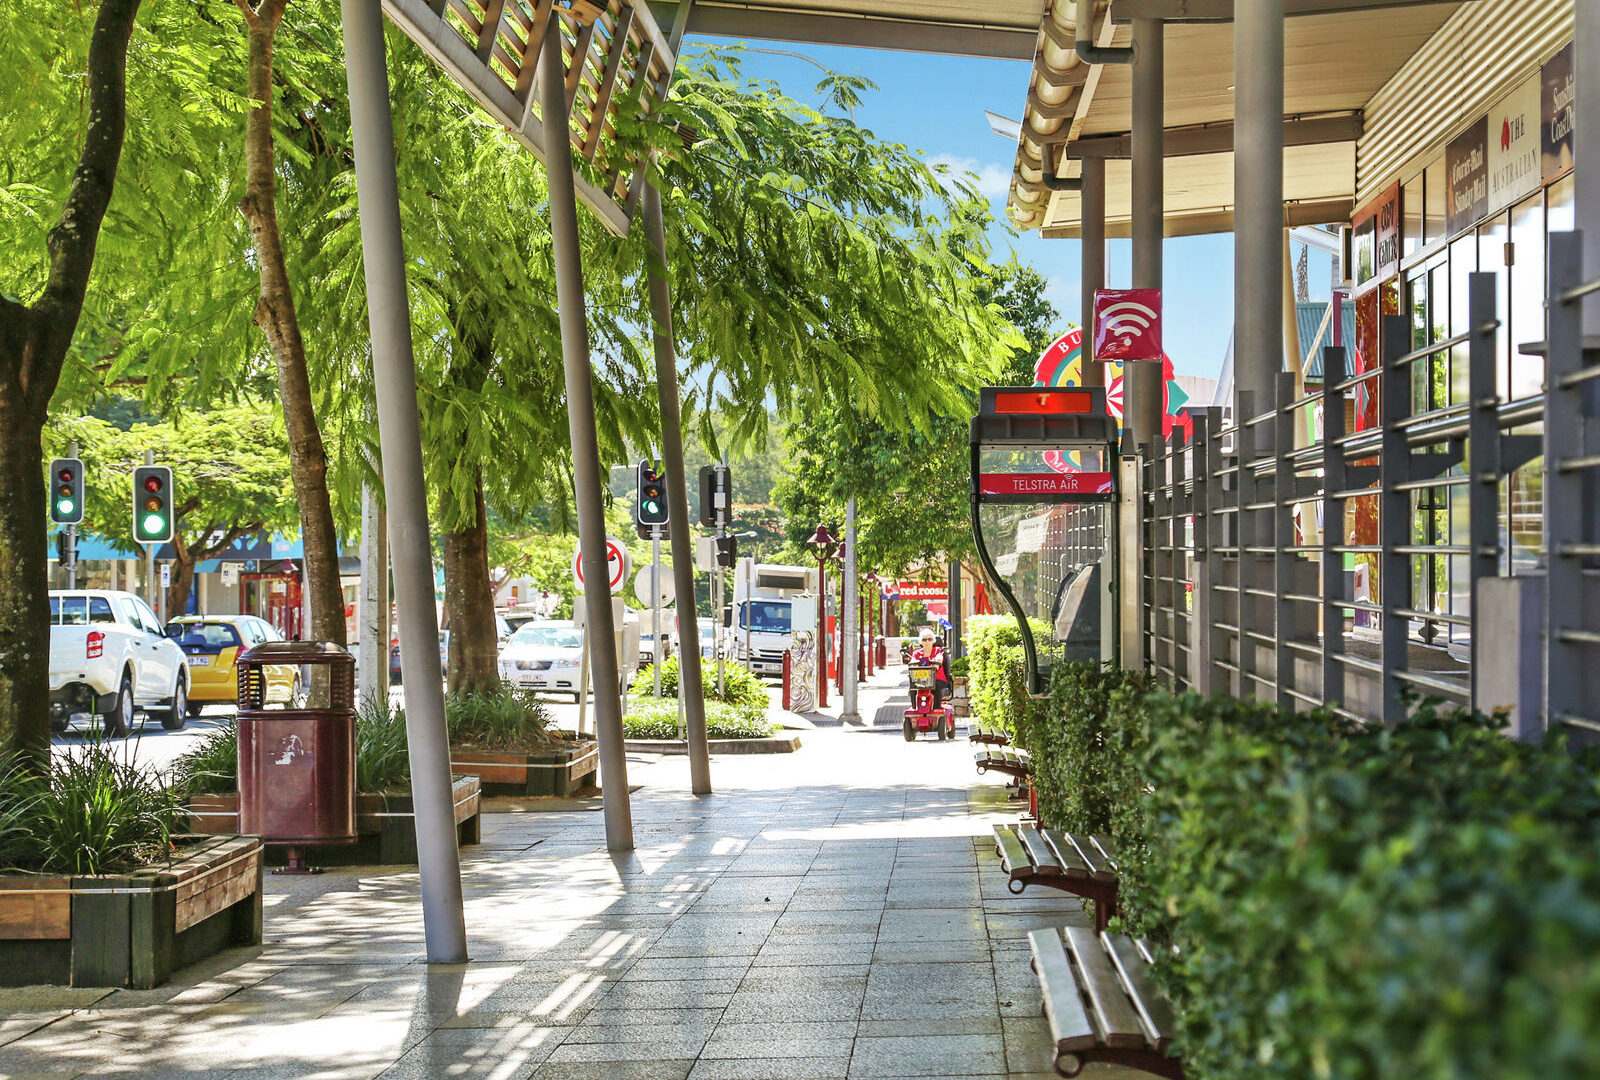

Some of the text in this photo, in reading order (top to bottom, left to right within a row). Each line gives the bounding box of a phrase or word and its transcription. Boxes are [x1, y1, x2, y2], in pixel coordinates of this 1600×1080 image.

[1510, 113, 1525, 144] THE
[1492, 147, 1537, 195] AUSTRALIAN
[1473, 174, 1486, 203] Mail
[1012, 479, 1057, 490] TELSTRA
[899, 585, 918, 595] red
